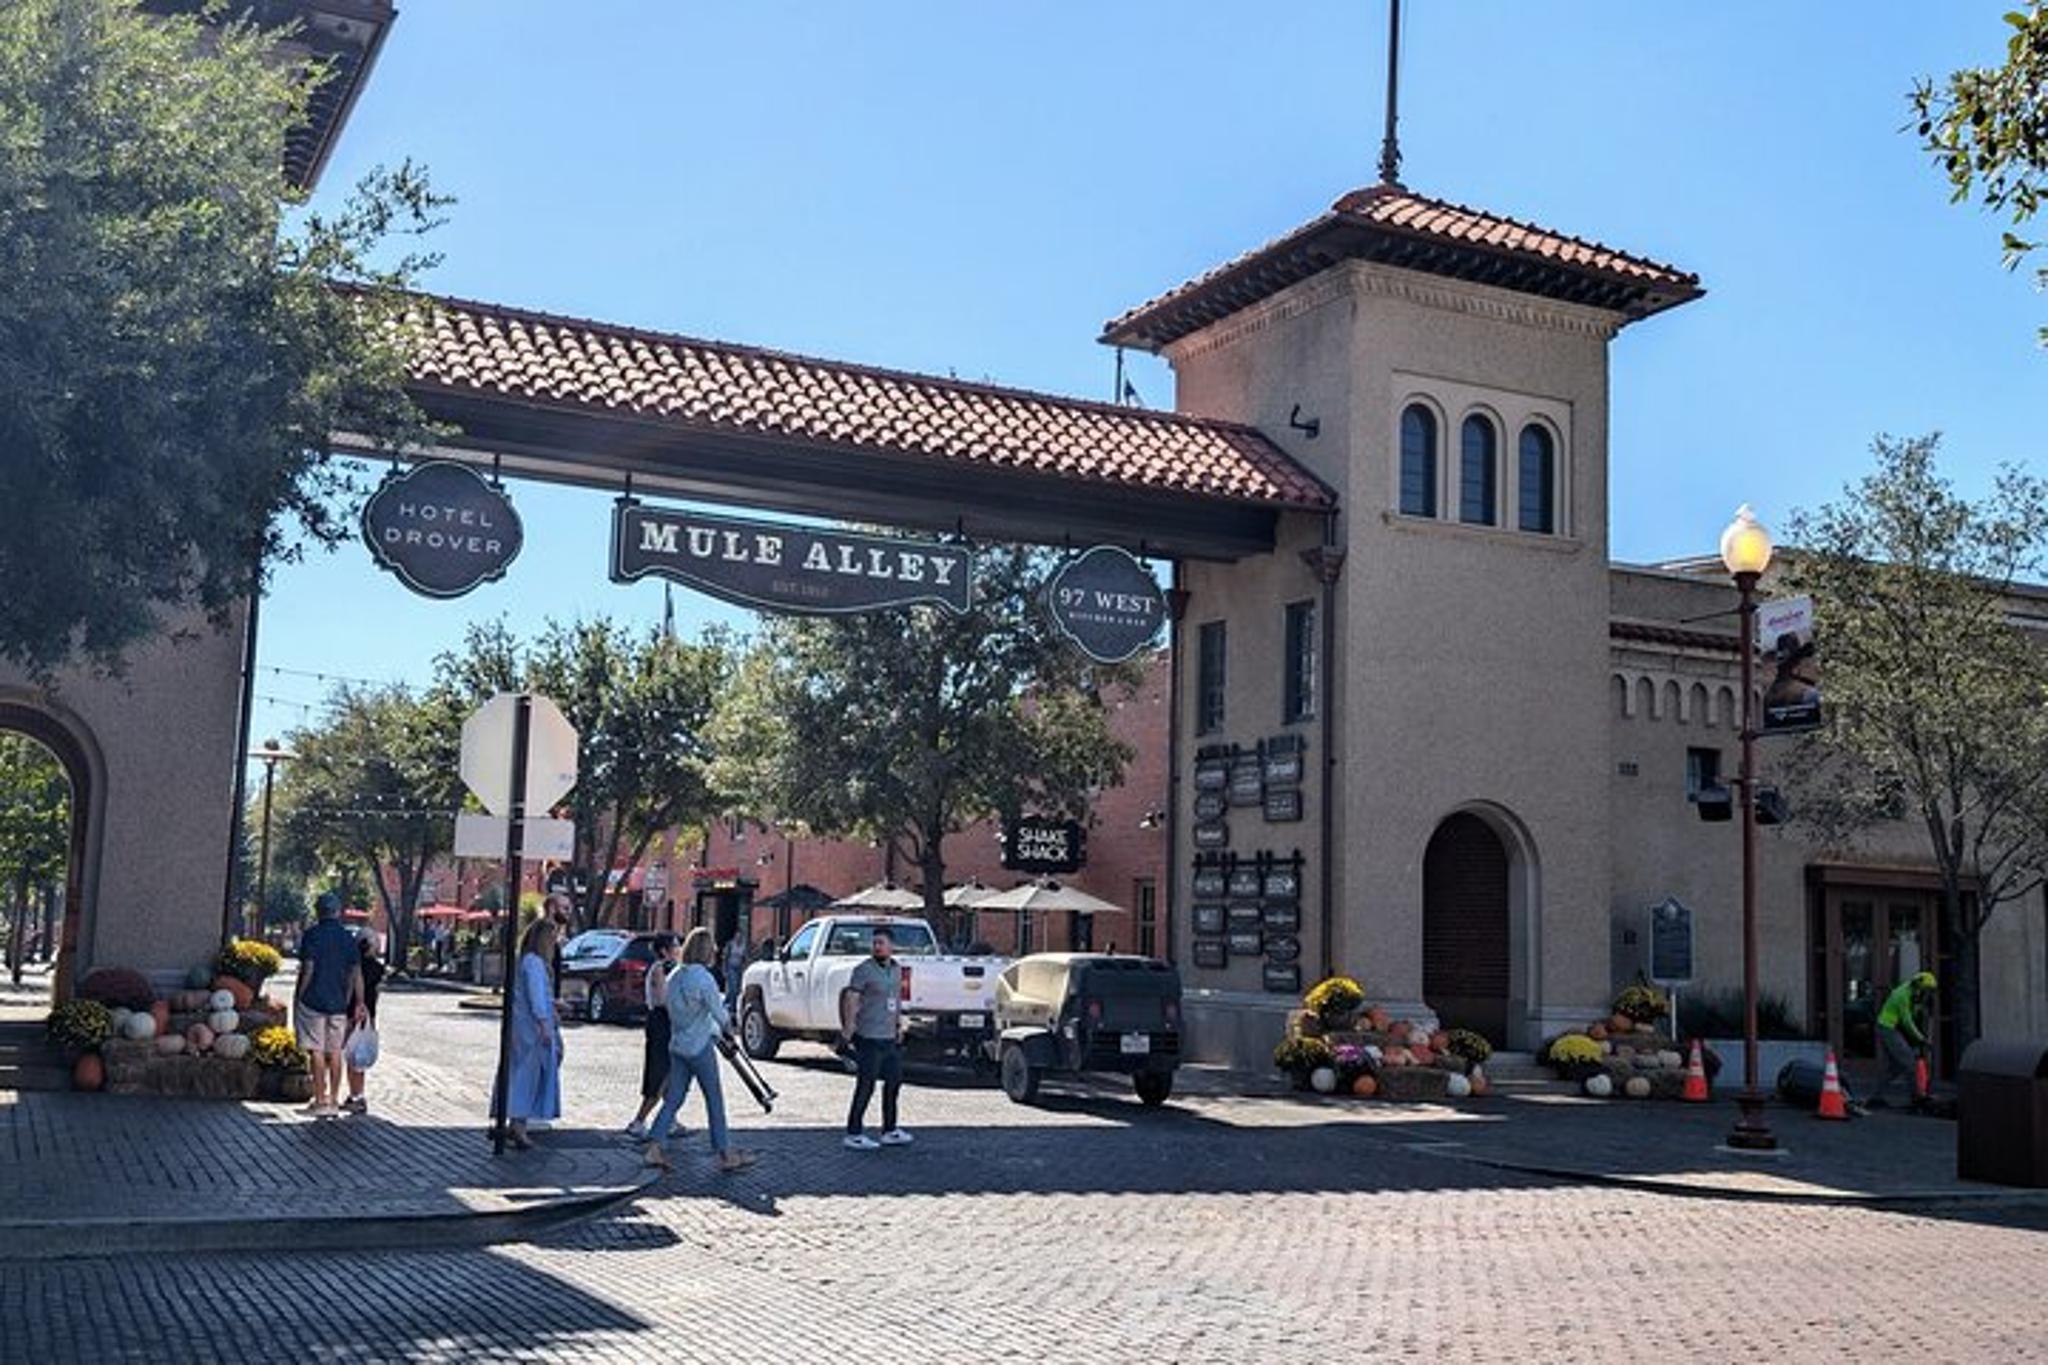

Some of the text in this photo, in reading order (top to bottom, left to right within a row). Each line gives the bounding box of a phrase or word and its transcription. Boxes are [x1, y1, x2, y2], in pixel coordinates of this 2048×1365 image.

[399, 502, 494, 528] HOTEL
[385, 526, 504, 555] DROVER
[638, 520, 958, 586] MULE ALLEY
[1060, 587, 1156, 615] 97 WEST
[1017, 826, 1069, 846] SHAKE
[1016, 843, 1069, 862] SHACK
